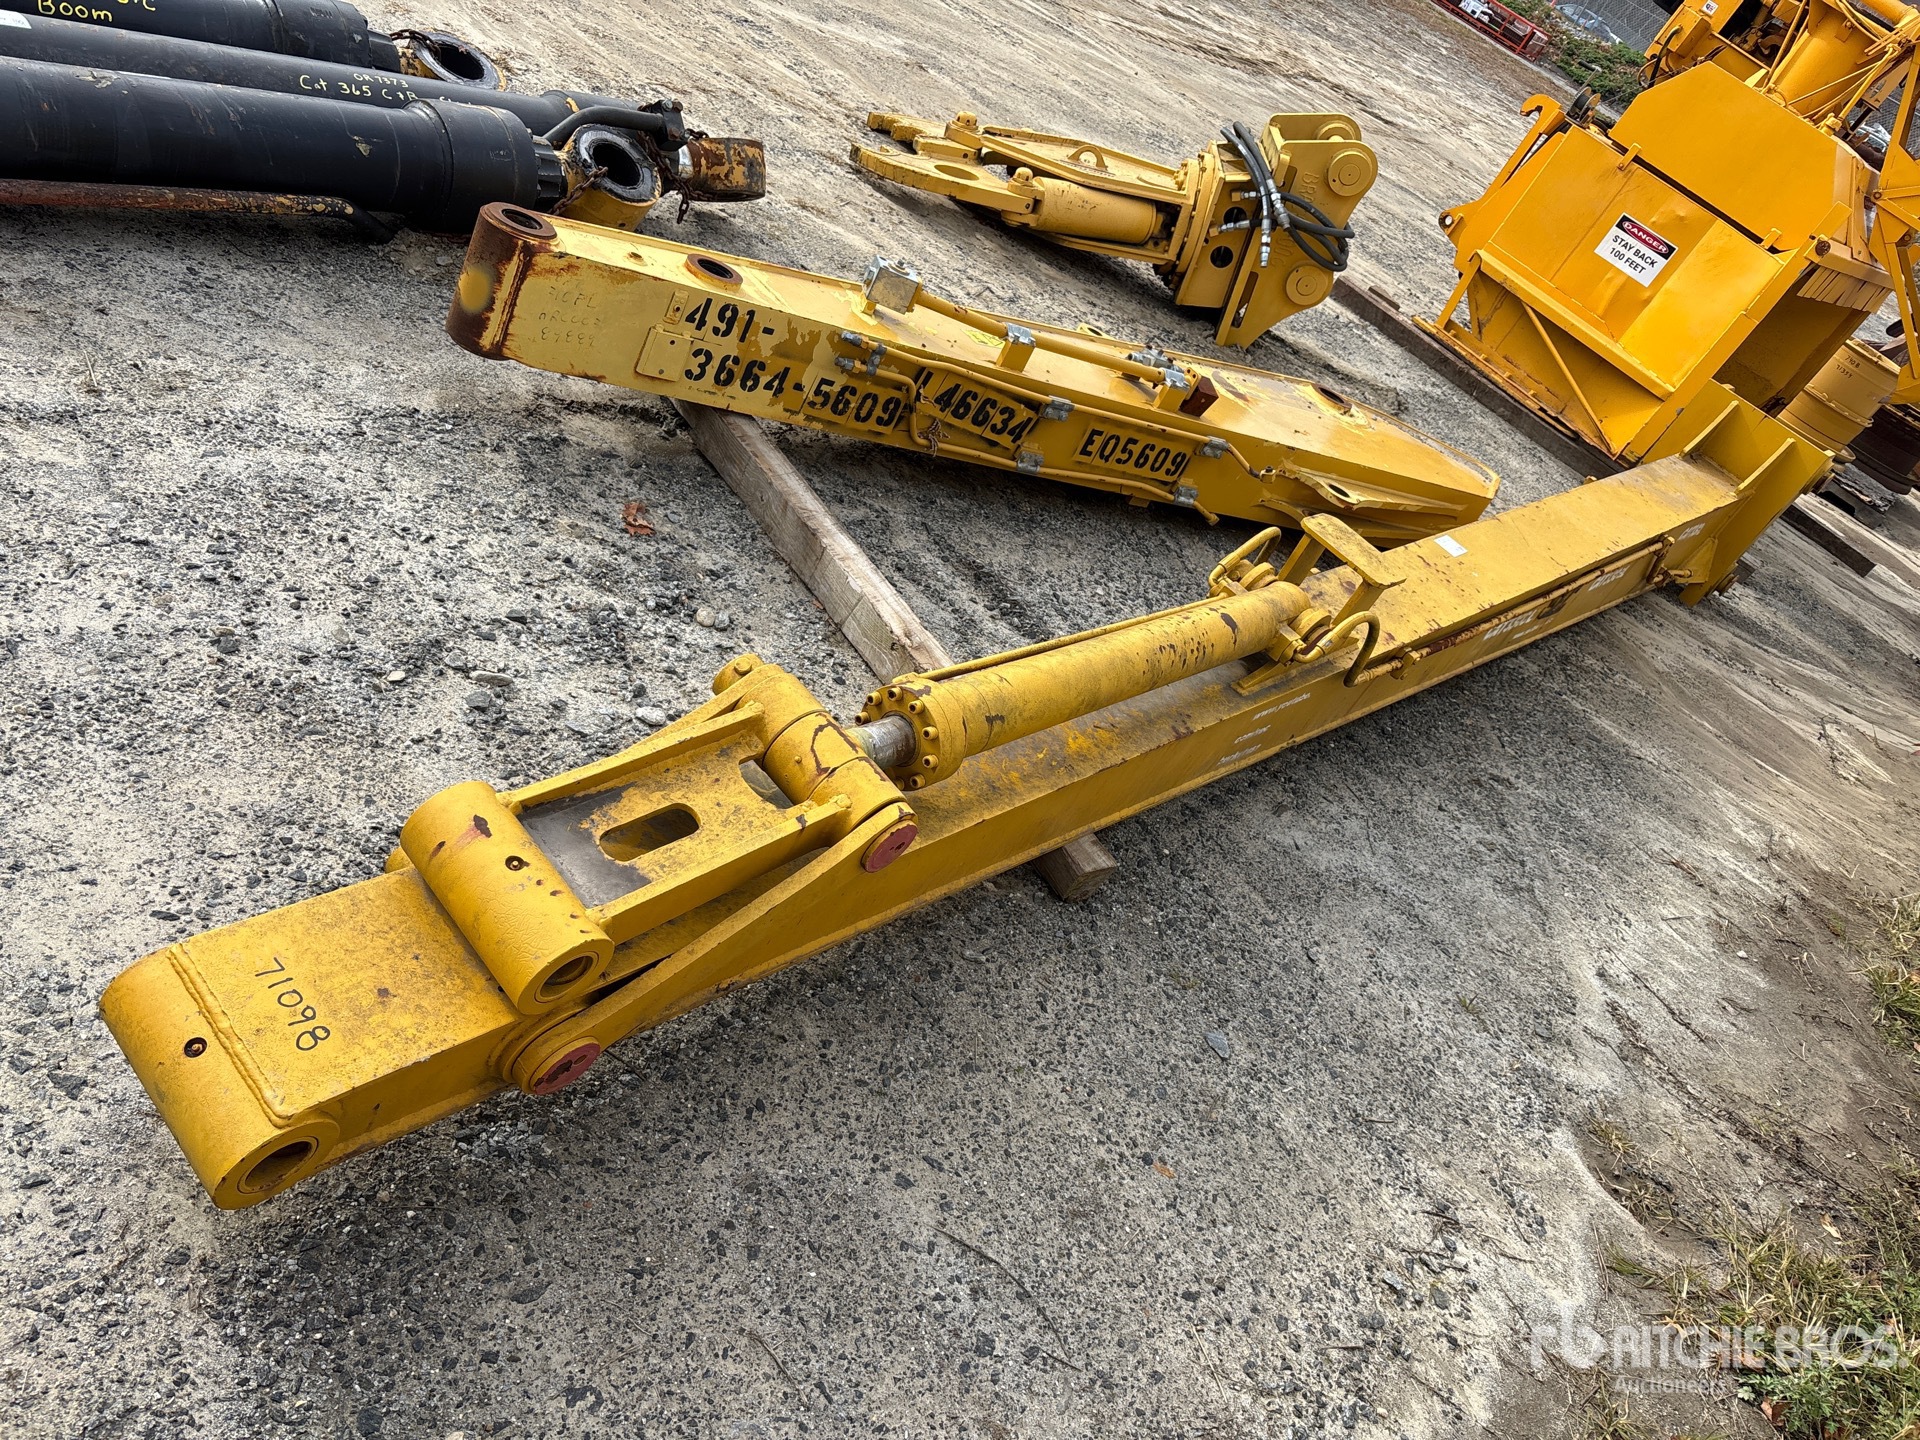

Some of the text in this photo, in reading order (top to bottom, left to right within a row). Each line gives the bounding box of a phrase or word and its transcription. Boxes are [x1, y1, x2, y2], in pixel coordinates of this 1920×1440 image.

[299, 74, 328, 92] Cat
[337, 82, 372, 97] 365
[1612, 234, 1658, 268] STAY BACK
[1624, 221, 1667, 253] DANGER
[1609, 247, 1647, 274] 100 FEET
[1079, 428, 1187, 478] EQ5609
[254, 956, 331, 1052] 71098
